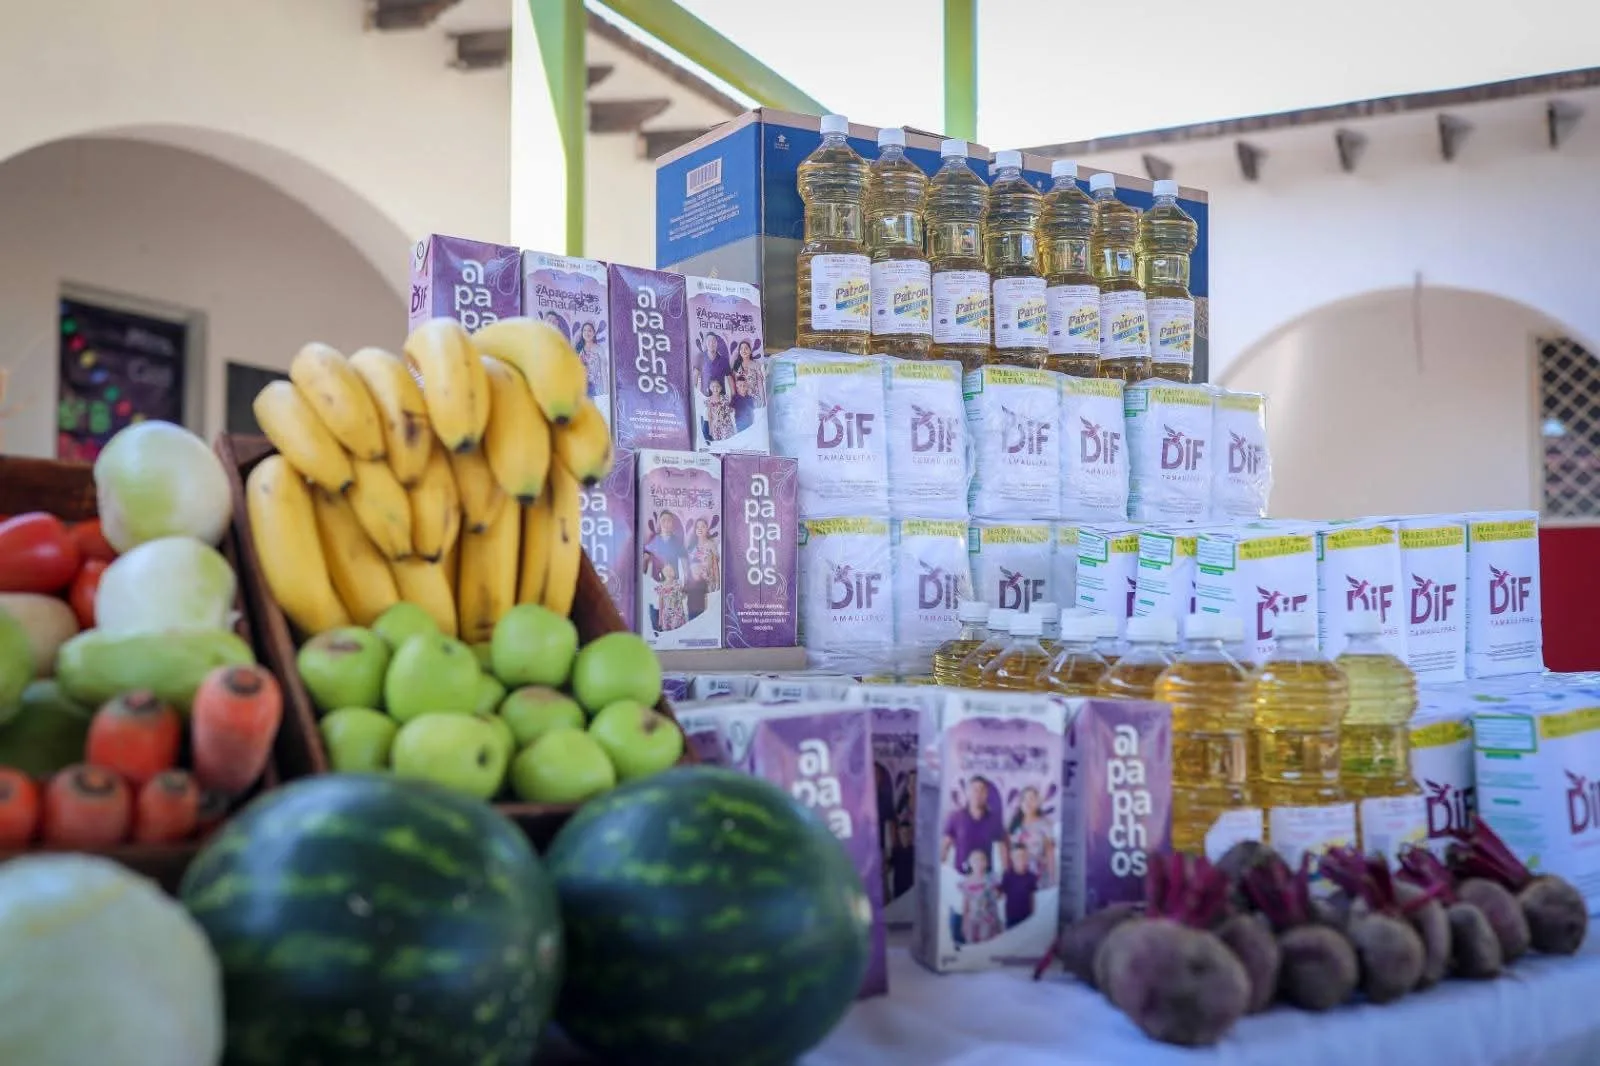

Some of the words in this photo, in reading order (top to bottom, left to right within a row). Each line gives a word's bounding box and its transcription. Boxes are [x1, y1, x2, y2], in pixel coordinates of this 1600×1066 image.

[454, 284, 492, 311] pa
[632, 308, 664, 333] pa
[638, 332, 670, 358] pa
[635, 350, 667, 375] ch
[638, 376, 669, 394] os
[744, 498, 776, 524] pa
[749, 521, 781, 549] pa
[746, 540, 776, 565] ch
[747, 568, 777, 586] os
[1107, 758, 1146, 793] pa
[1113, 791, 1152, 824] pa
[828, 808, 853, 840] a
[1109, 814, 1147, 848] ch
[1111, 851, 1148, 878] os
